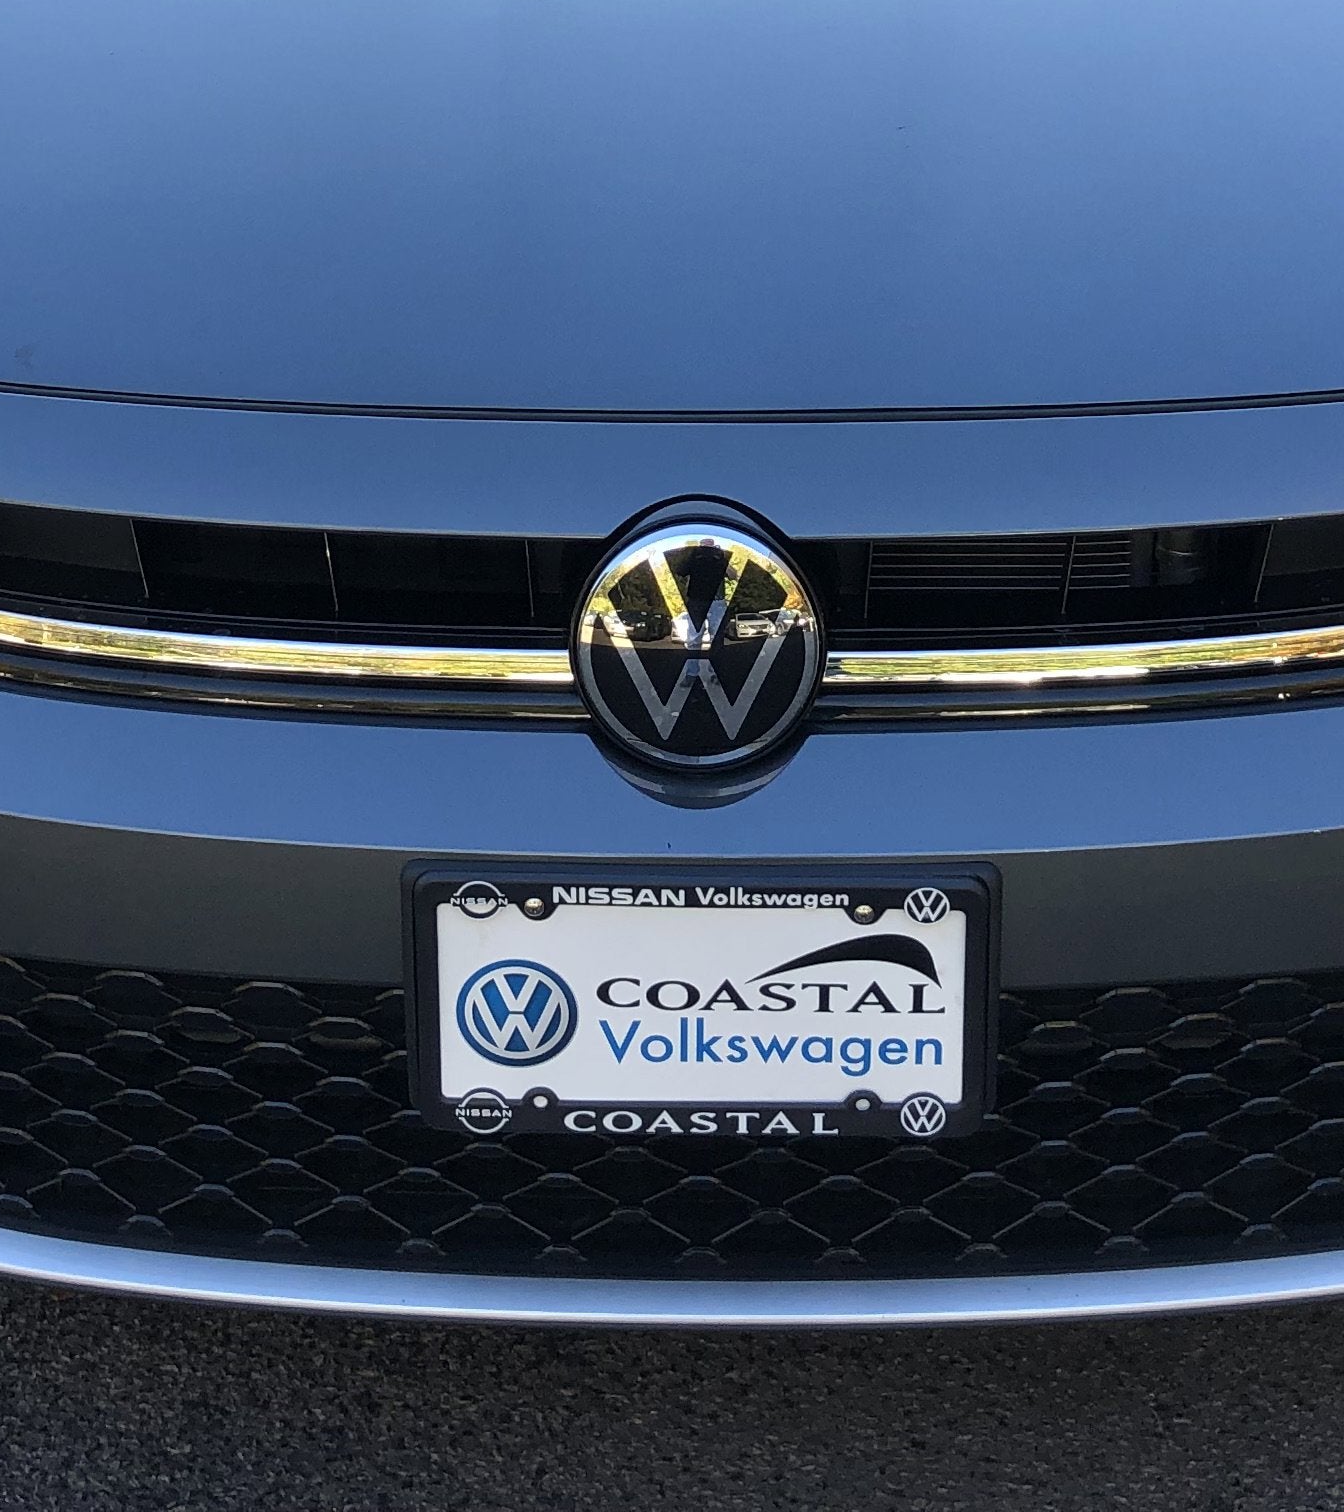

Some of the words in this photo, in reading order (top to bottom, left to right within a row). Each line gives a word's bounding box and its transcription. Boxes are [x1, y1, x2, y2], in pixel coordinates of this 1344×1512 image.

[449, 897, 509, 907] NISSAN
[552, 886, 686, 906] NISSAN
[695, 886, 850, 909] Volkswagen
[596, 978, 946, 1014] COASTAL
[599, 1016, 944, 1077] Volkswagen
[455, 1107, 513, 1118] NISSAN
[563, 1109, 840, 1136] COASTAL
